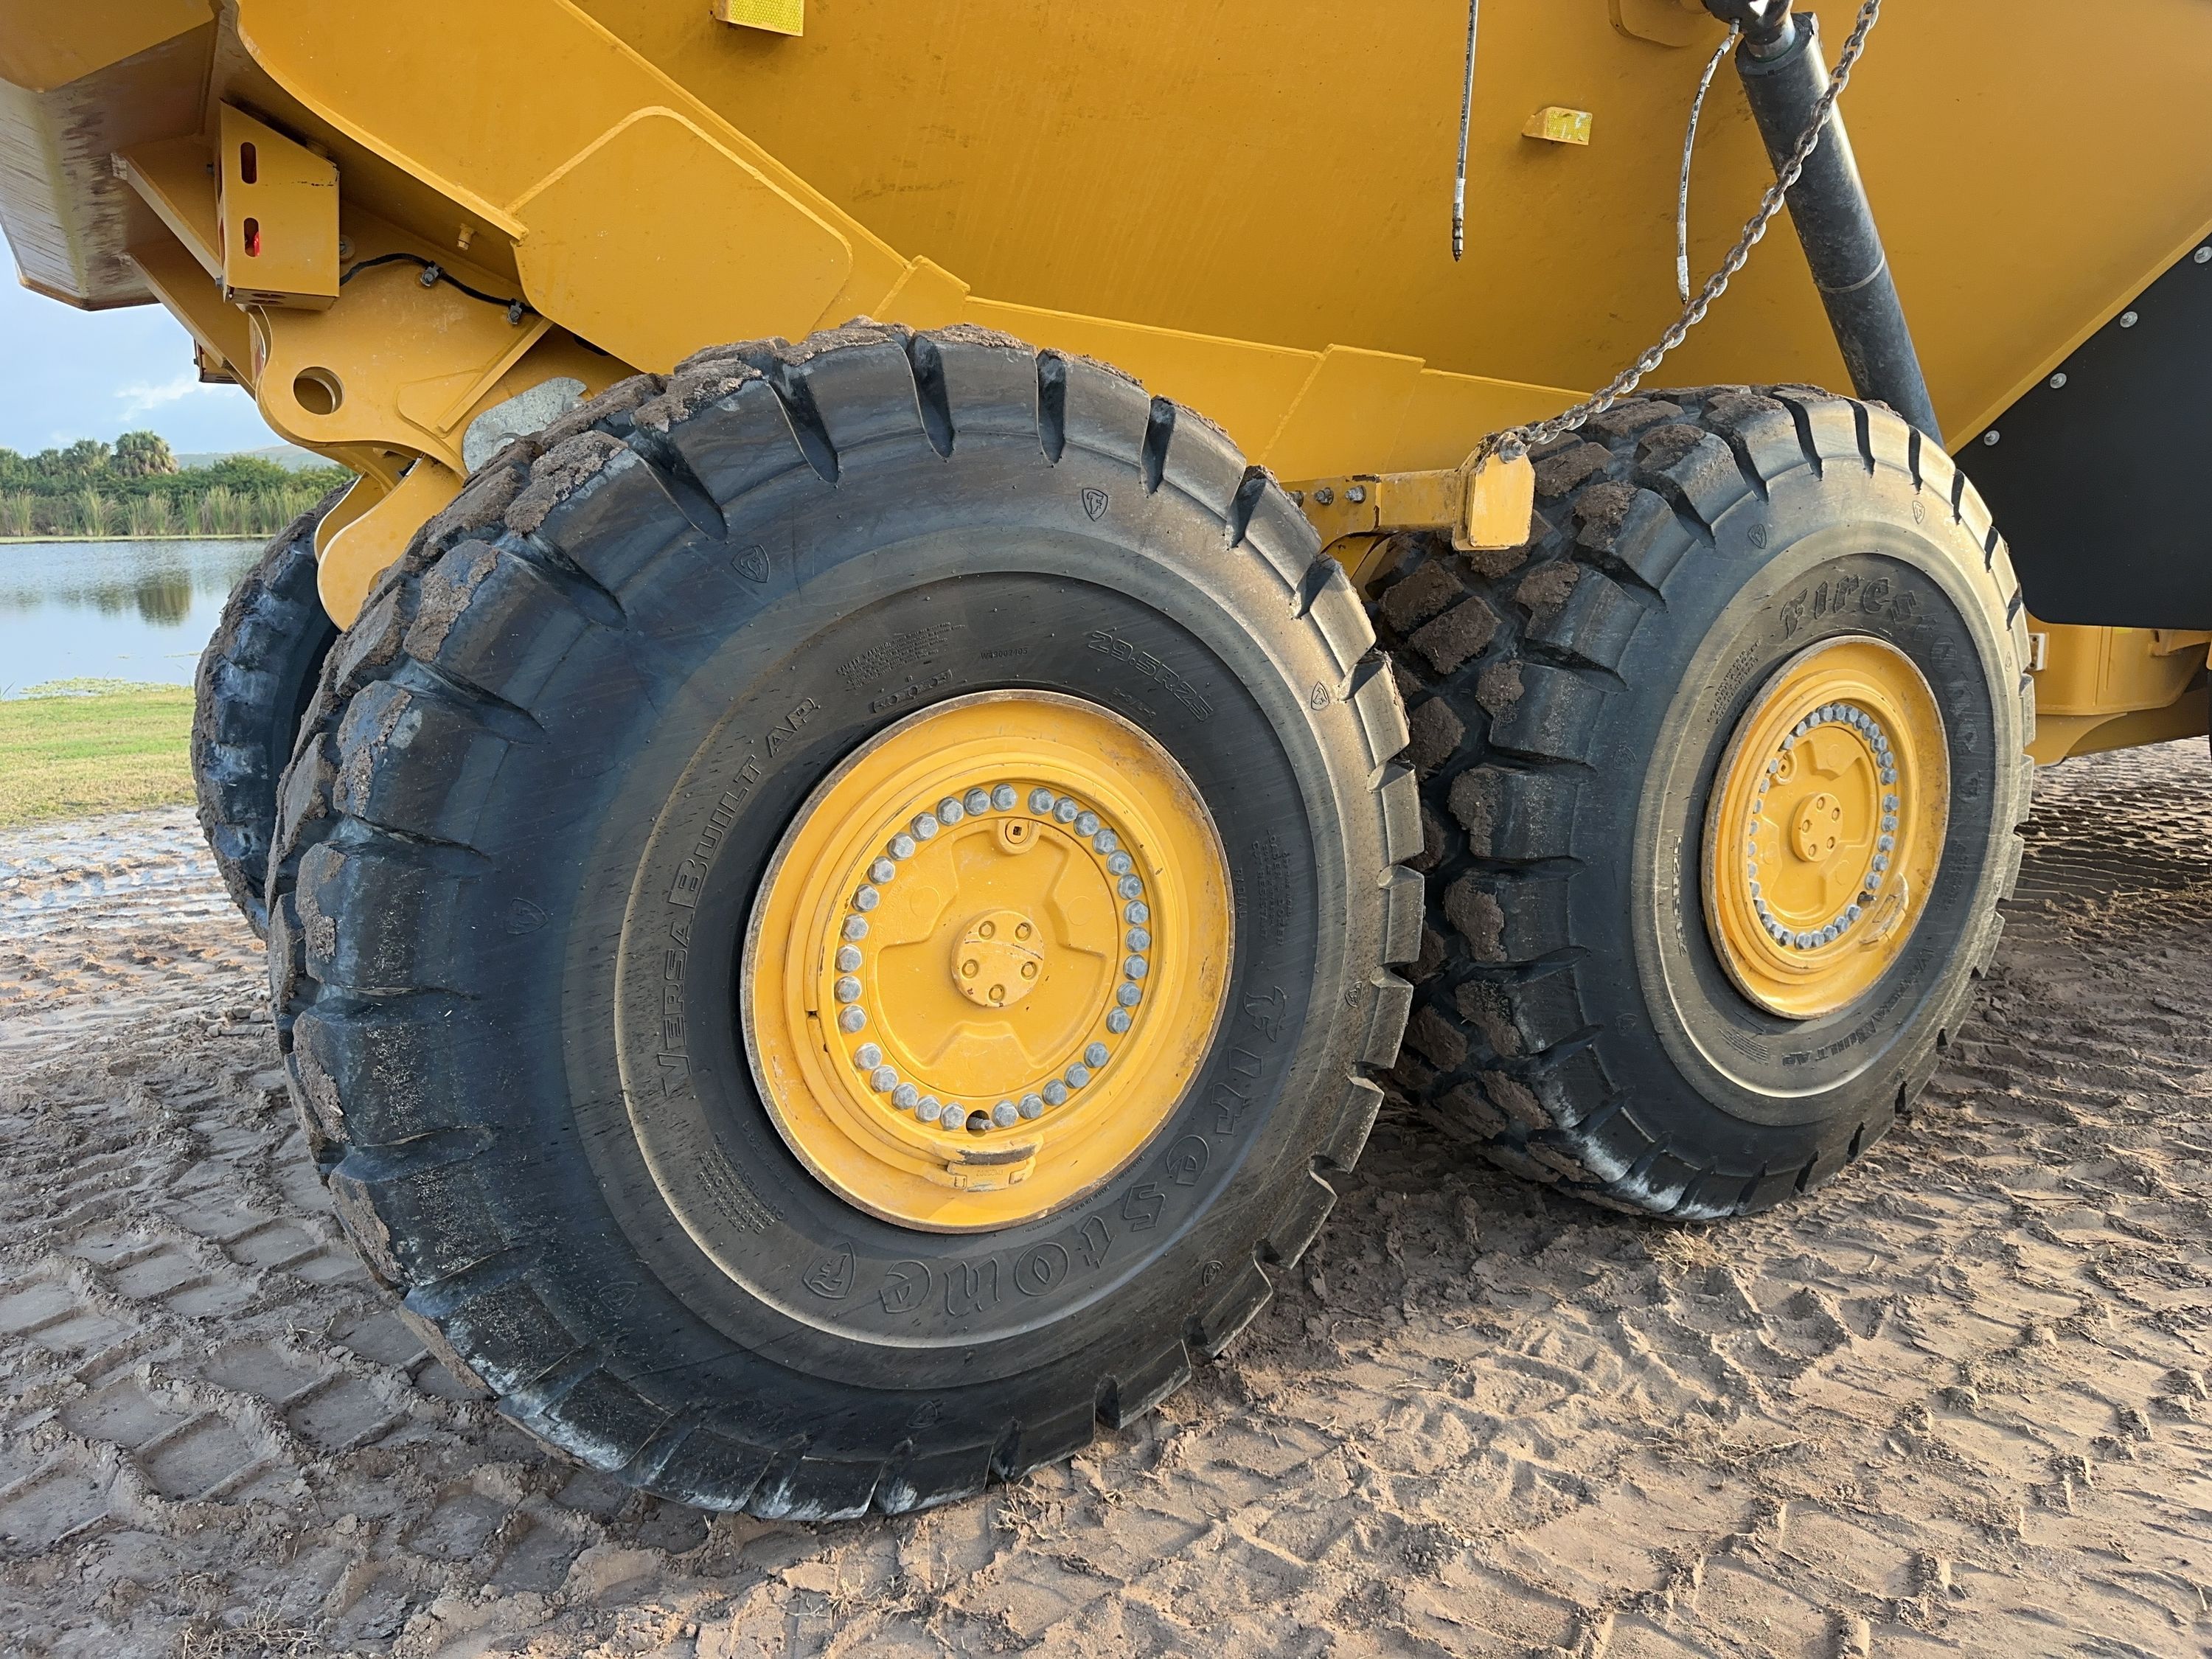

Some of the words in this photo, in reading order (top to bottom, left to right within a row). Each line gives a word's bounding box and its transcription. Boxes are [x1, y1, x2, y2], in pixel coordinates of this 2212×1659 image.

[1088, 630, 1214, 722] 29.5R25
[766, 698, 815, 758] AP
[1233, 867, 1248, 920] RADIAL
[1256, 871, 1267, 939] RESISTANT
[1673, 835, 1687, 956] 29.5R25
[714, 1130, 763, 1199] RESISTANT
[881, 985, 1286, 1315] Firestone
[694, 1171, 717, 1197] ROAD
[697, 1150, 764, 1235] EARTHMOVER
[762, 1199, 784, 1221] CUT
[727, 1214, 745, 1234] OFF
[757, 1208, 775, 1228] 200
